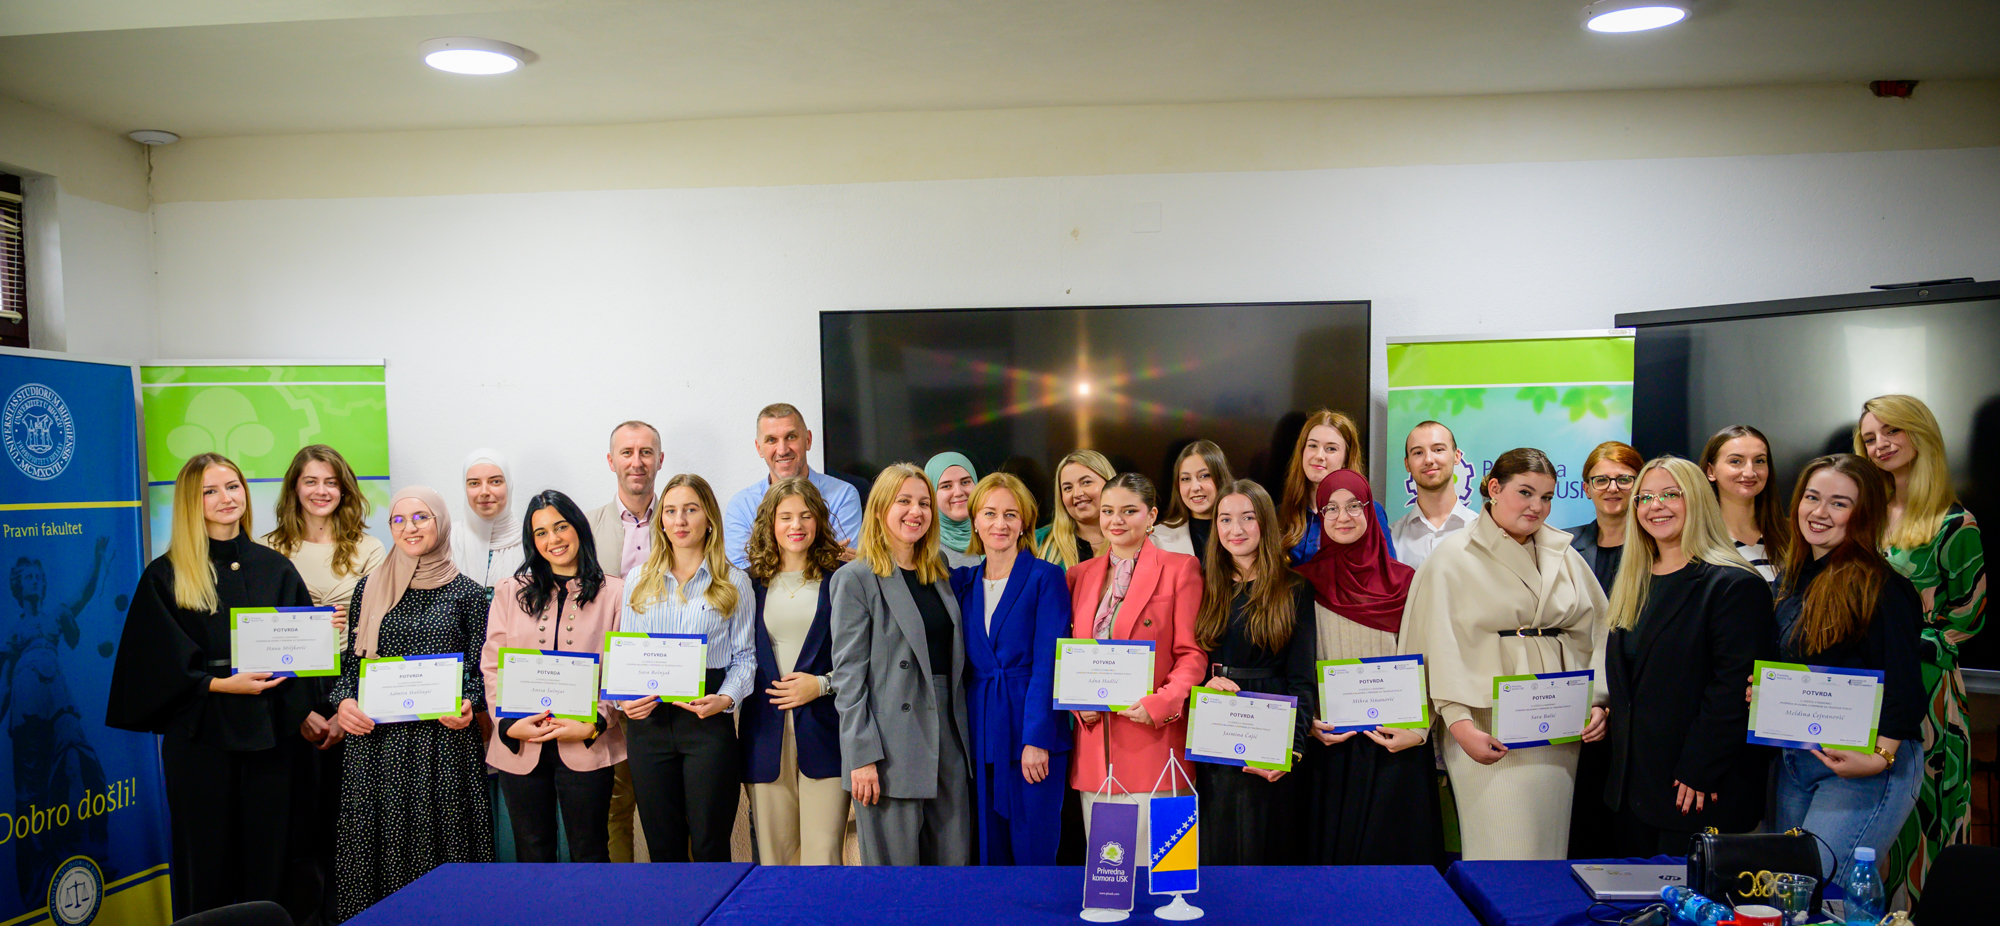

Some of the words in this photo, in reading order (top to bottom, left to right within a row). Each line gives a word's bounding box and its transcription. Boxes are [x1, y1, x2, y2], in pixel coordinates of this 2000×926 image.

[16, 386, 60, 407] STUDIORUM
[1556, 481, 1584, 499] US
[3, 523, 39, 538] Pravni
[41, 522, 83, 536] fakultet
[1802, 690, 1832, 698] POTVRDA
[0, 804, 70, 844] Dobro
[78, 776, 136, 820] došli!
[1092, 873, 1115, 882] komora
[1096, 866, 1125, 876] Privredna
